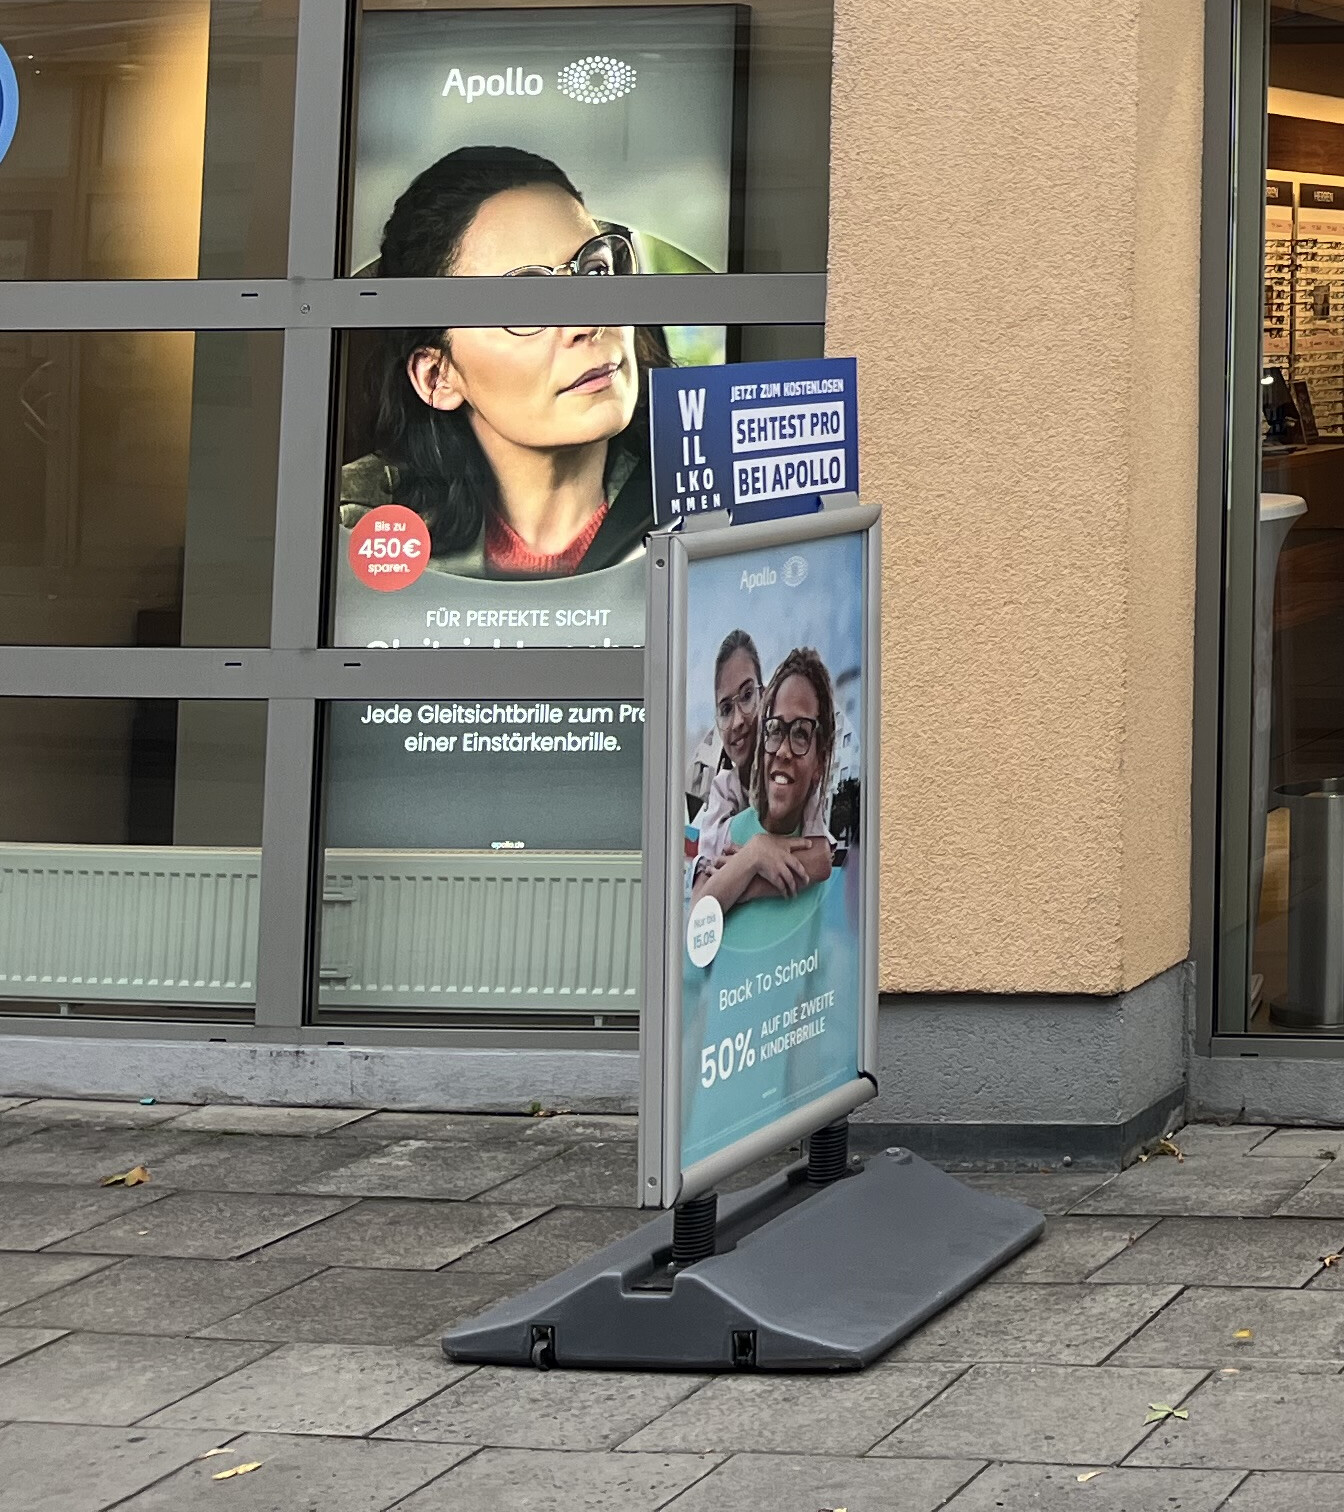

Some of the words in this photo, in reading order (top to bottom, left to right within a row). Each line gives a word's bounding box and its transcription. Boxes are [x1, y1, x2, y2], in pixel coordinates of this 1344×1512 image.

[442, 67, 543, 103] Apollo
[731, 385, 757, 402] JETZT
[760, 383, 781, 399] ZUM
[784, 379, 844, 396] KOSTENLOSEN
[736, 413, 806, 444] SEHTEST
[810, 410, 840, 436] PRO
[738, 466, 767, 496] BEI
[771, 456, 841, 492] APOLLO
[374, 521, 390, 532] Bis
[393, 522, 406, 532] zu
[358, 538, 422, 558] 450€
[367, 562, 410, 575] sparen.
[740, 566, 777, 594] Apollo
[426, 607, 460, 628] FÜR
[466, 609, 549, 627] PERFEKTE
[555, 609, 611, 626] SICHT
[361, 704, 412, 724] Jede
[417, 703, 563, 724] Gleitsichtbrille
[568, 706, 614, 723] zum
[404, 732, 457, 752] einer
[462, 732, 622, 752] Einstärkenbrille.
[491, 841, 525, 850] apollo.de
[719, 978, 752, 1011] Back
[756, 973, 772, 995] To
[775, 949, 820, 987] School
[760, 1016, 780, 1039] AUF
[783, 1006, 799, 1028] DIE
[800, 990, 835, 1020] ZWEITE
[760, 1016, 826, 1062] KINDERBRILLE
[701, 1028, 755, 1089] 50%
